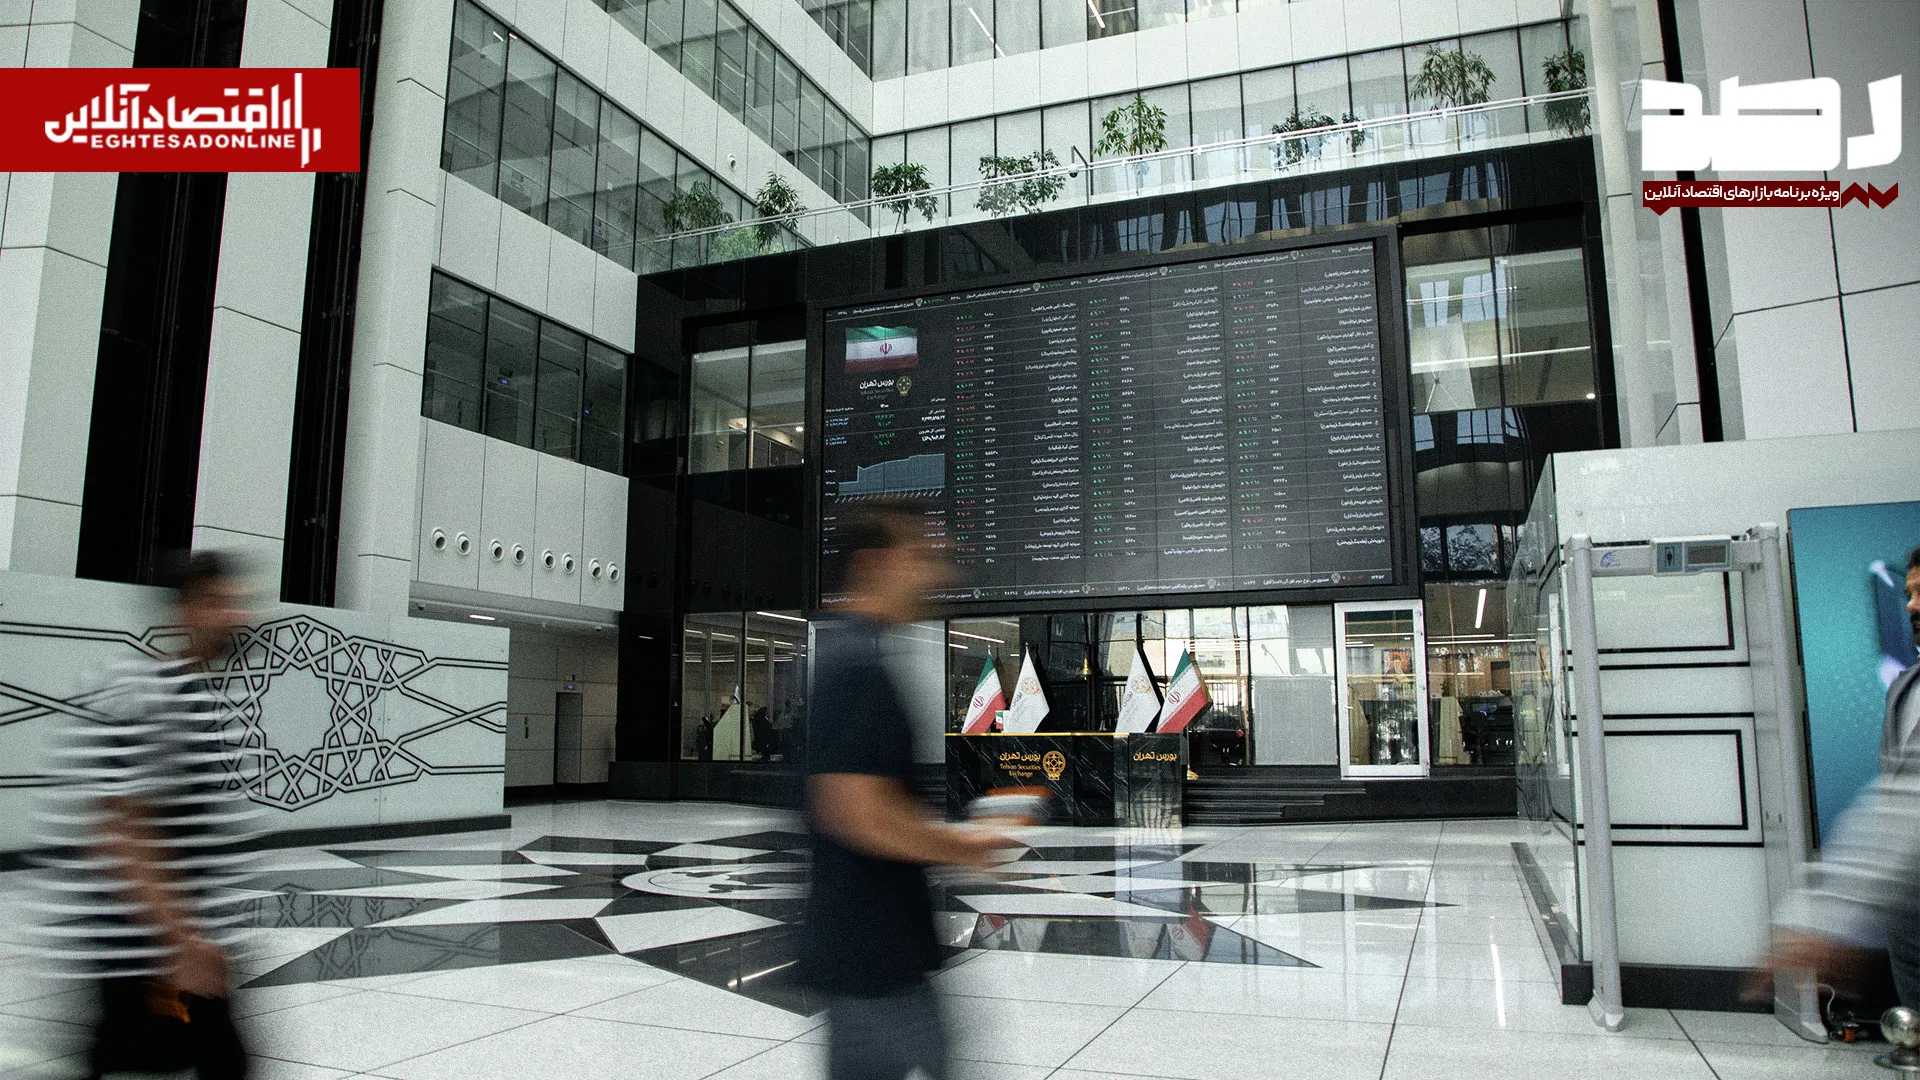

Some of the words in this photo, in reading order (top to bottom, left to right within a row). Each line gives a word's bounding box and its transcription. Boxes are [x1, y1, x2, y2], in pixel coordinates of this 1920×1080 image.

[999, 751, 1021, 761] تهران
[1021, 753, 1042, 763] بورس
[1133, 751, 1155, 762] تهران
[1155, 753, 1178, 762] بورس
